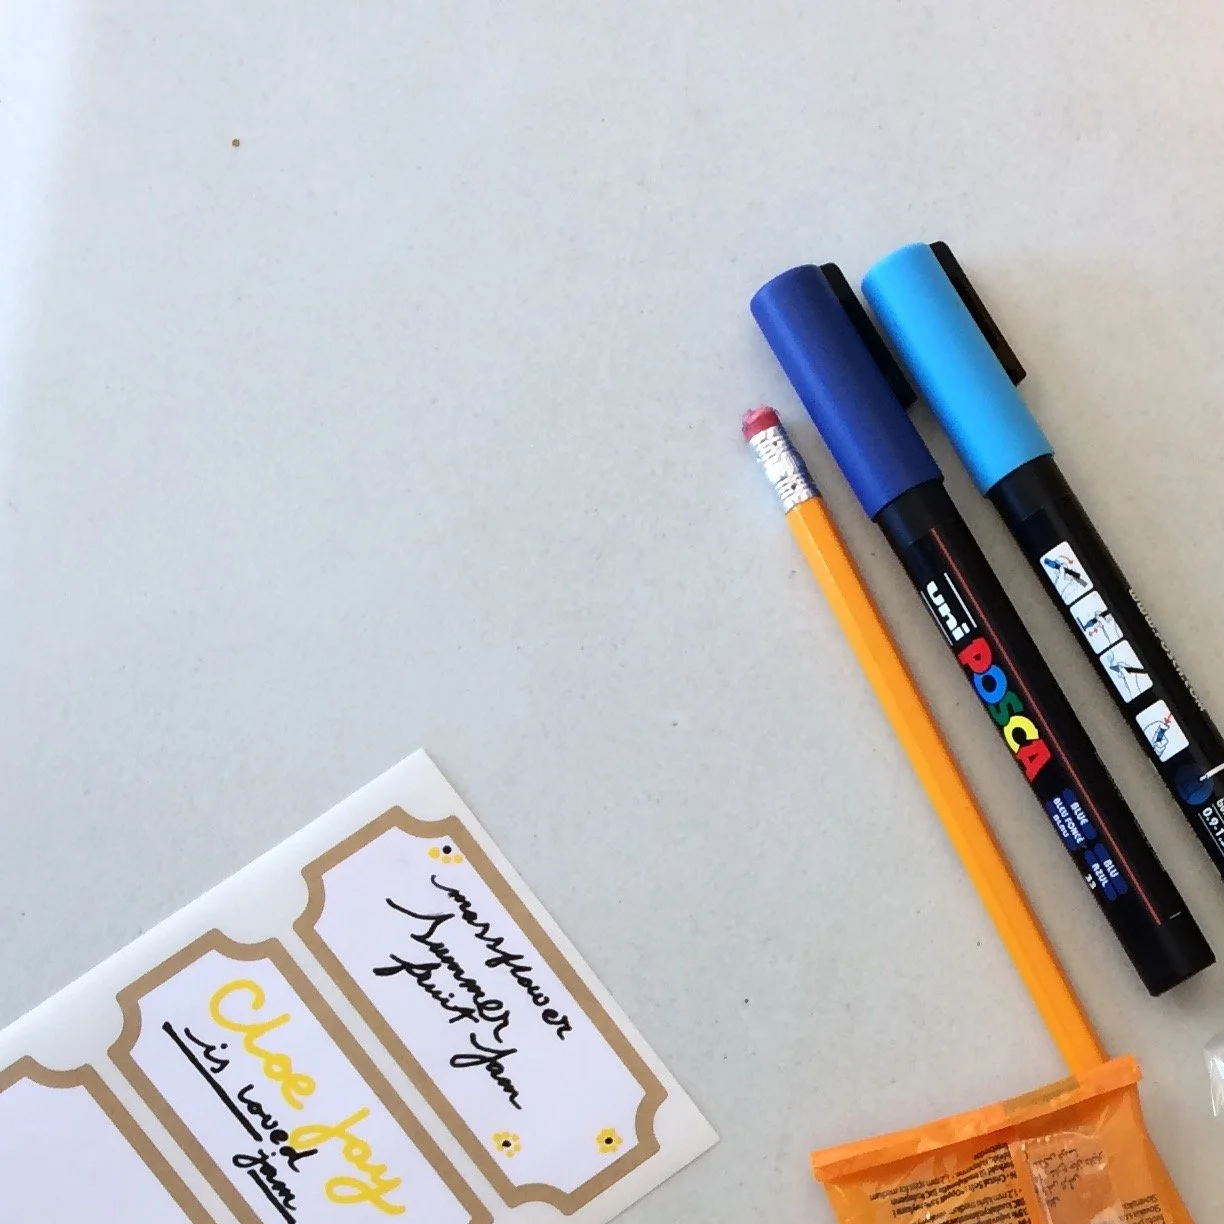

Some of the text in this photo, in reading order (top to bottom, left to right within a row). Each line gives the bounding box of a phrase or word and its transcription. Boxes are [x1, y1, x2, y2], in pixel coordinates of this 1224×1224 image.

[922, 577, 1058, 784] uni POSCA
[1068, 801, 1089, 827] BLUE
[1089, 861, 1110, 889] AZUL
[1101, 857, 1120, 880] BLU
[184, 1027, 230, 1074] is
[208, 978, 317, 1111] Cloe
